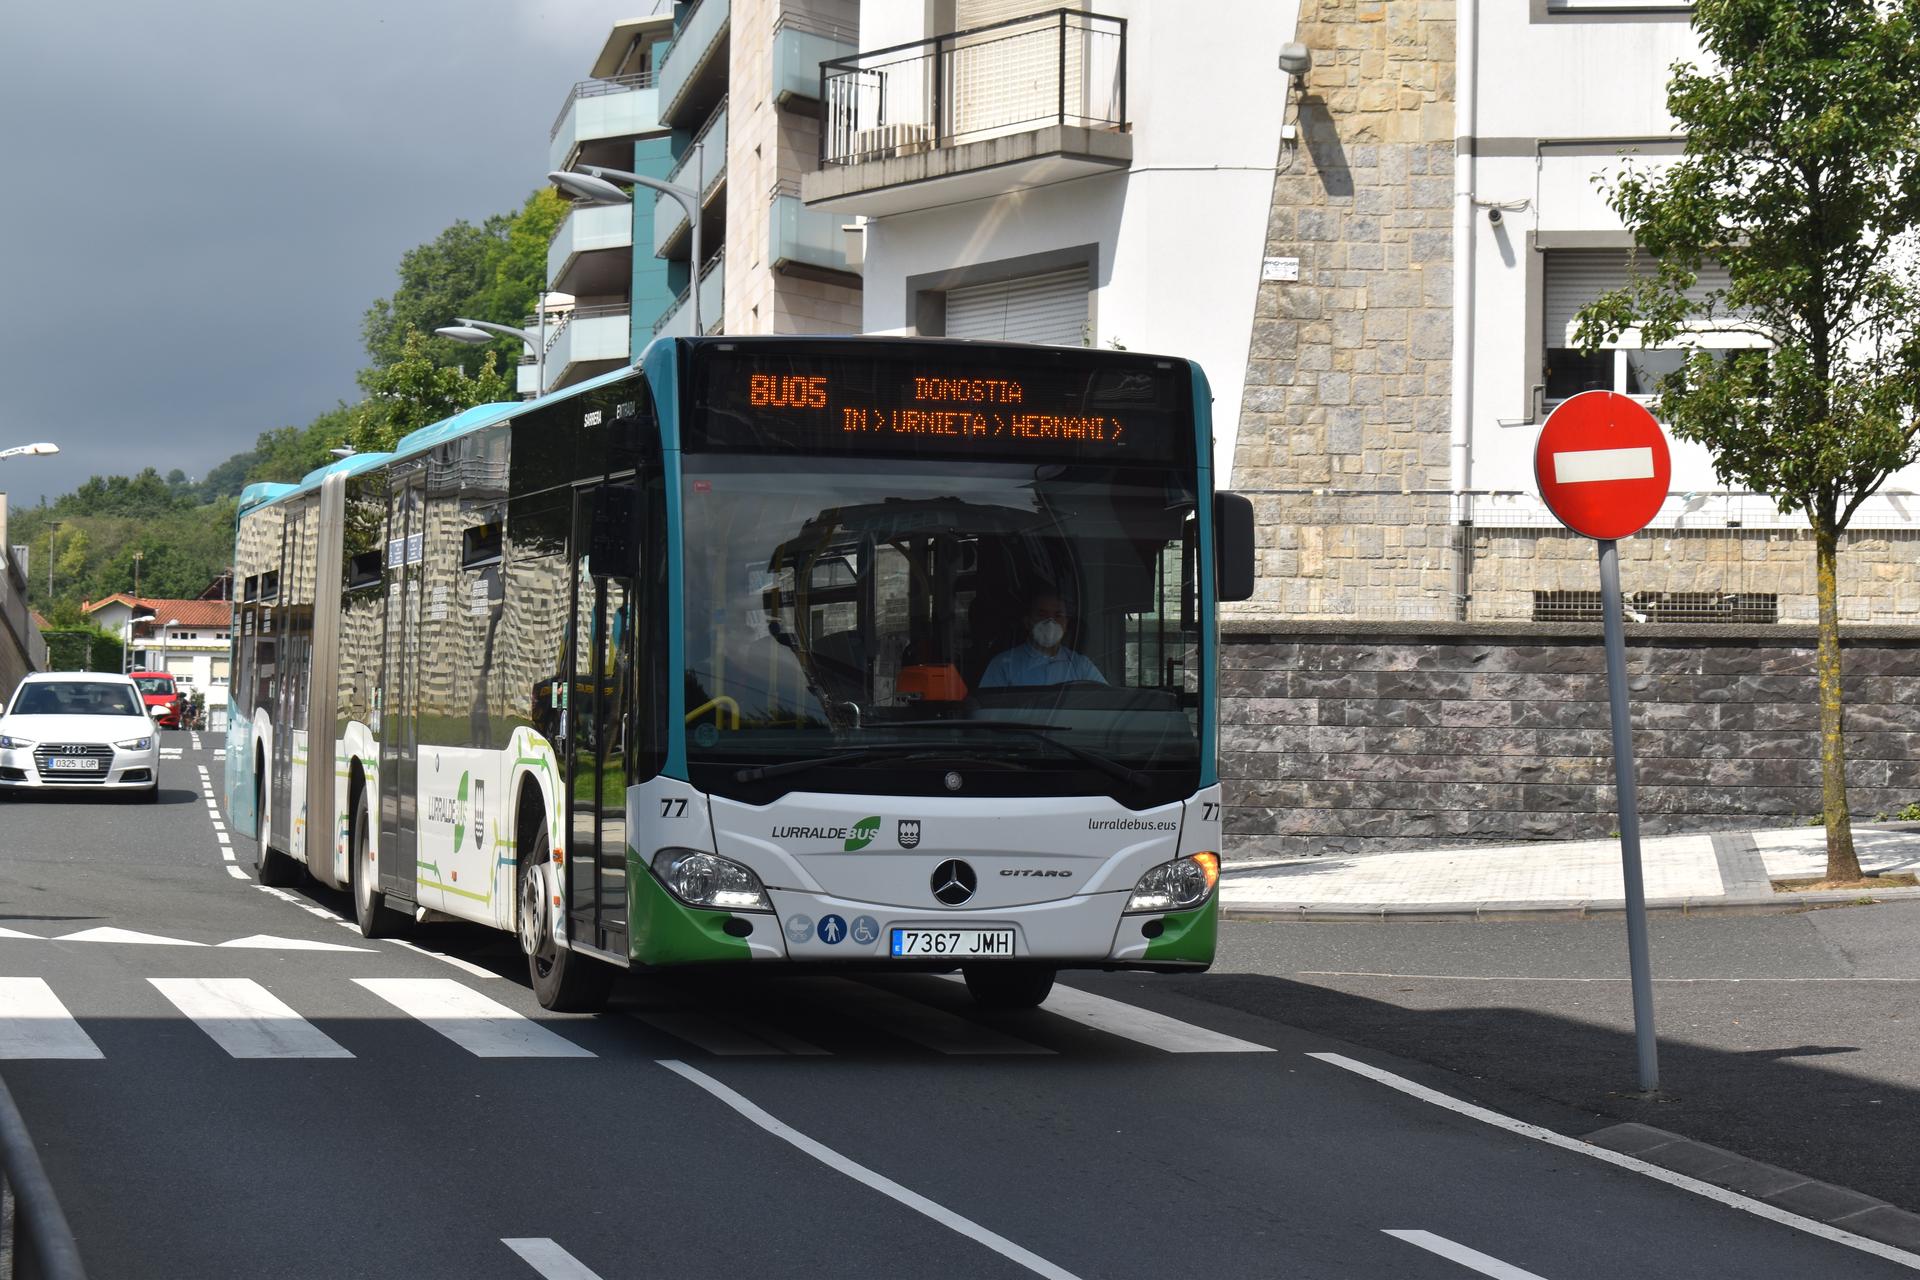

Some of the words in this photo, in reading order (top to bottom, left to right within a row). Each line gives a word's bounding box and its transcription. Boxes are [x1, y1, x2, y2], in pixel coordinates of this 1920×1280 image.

[915, 377, 1024, 403] DONOSTIA
[843, 408, 866, 431] IN
[893, 410, 986, 436] URNIETA
[1012, 415, 1104, 439] HERNANI
[56, 760, 76, 768] 0325
[81, 760, 97, 768] LGR
[660, 800, 688, 817] 77
[1088, 818, 1177, 831] lurraldebus.eus
[1000, 869, 1073, 878] CITARO
[906, 933, 961, 953] 7367
[969, 933, 1008, 953] JMH
